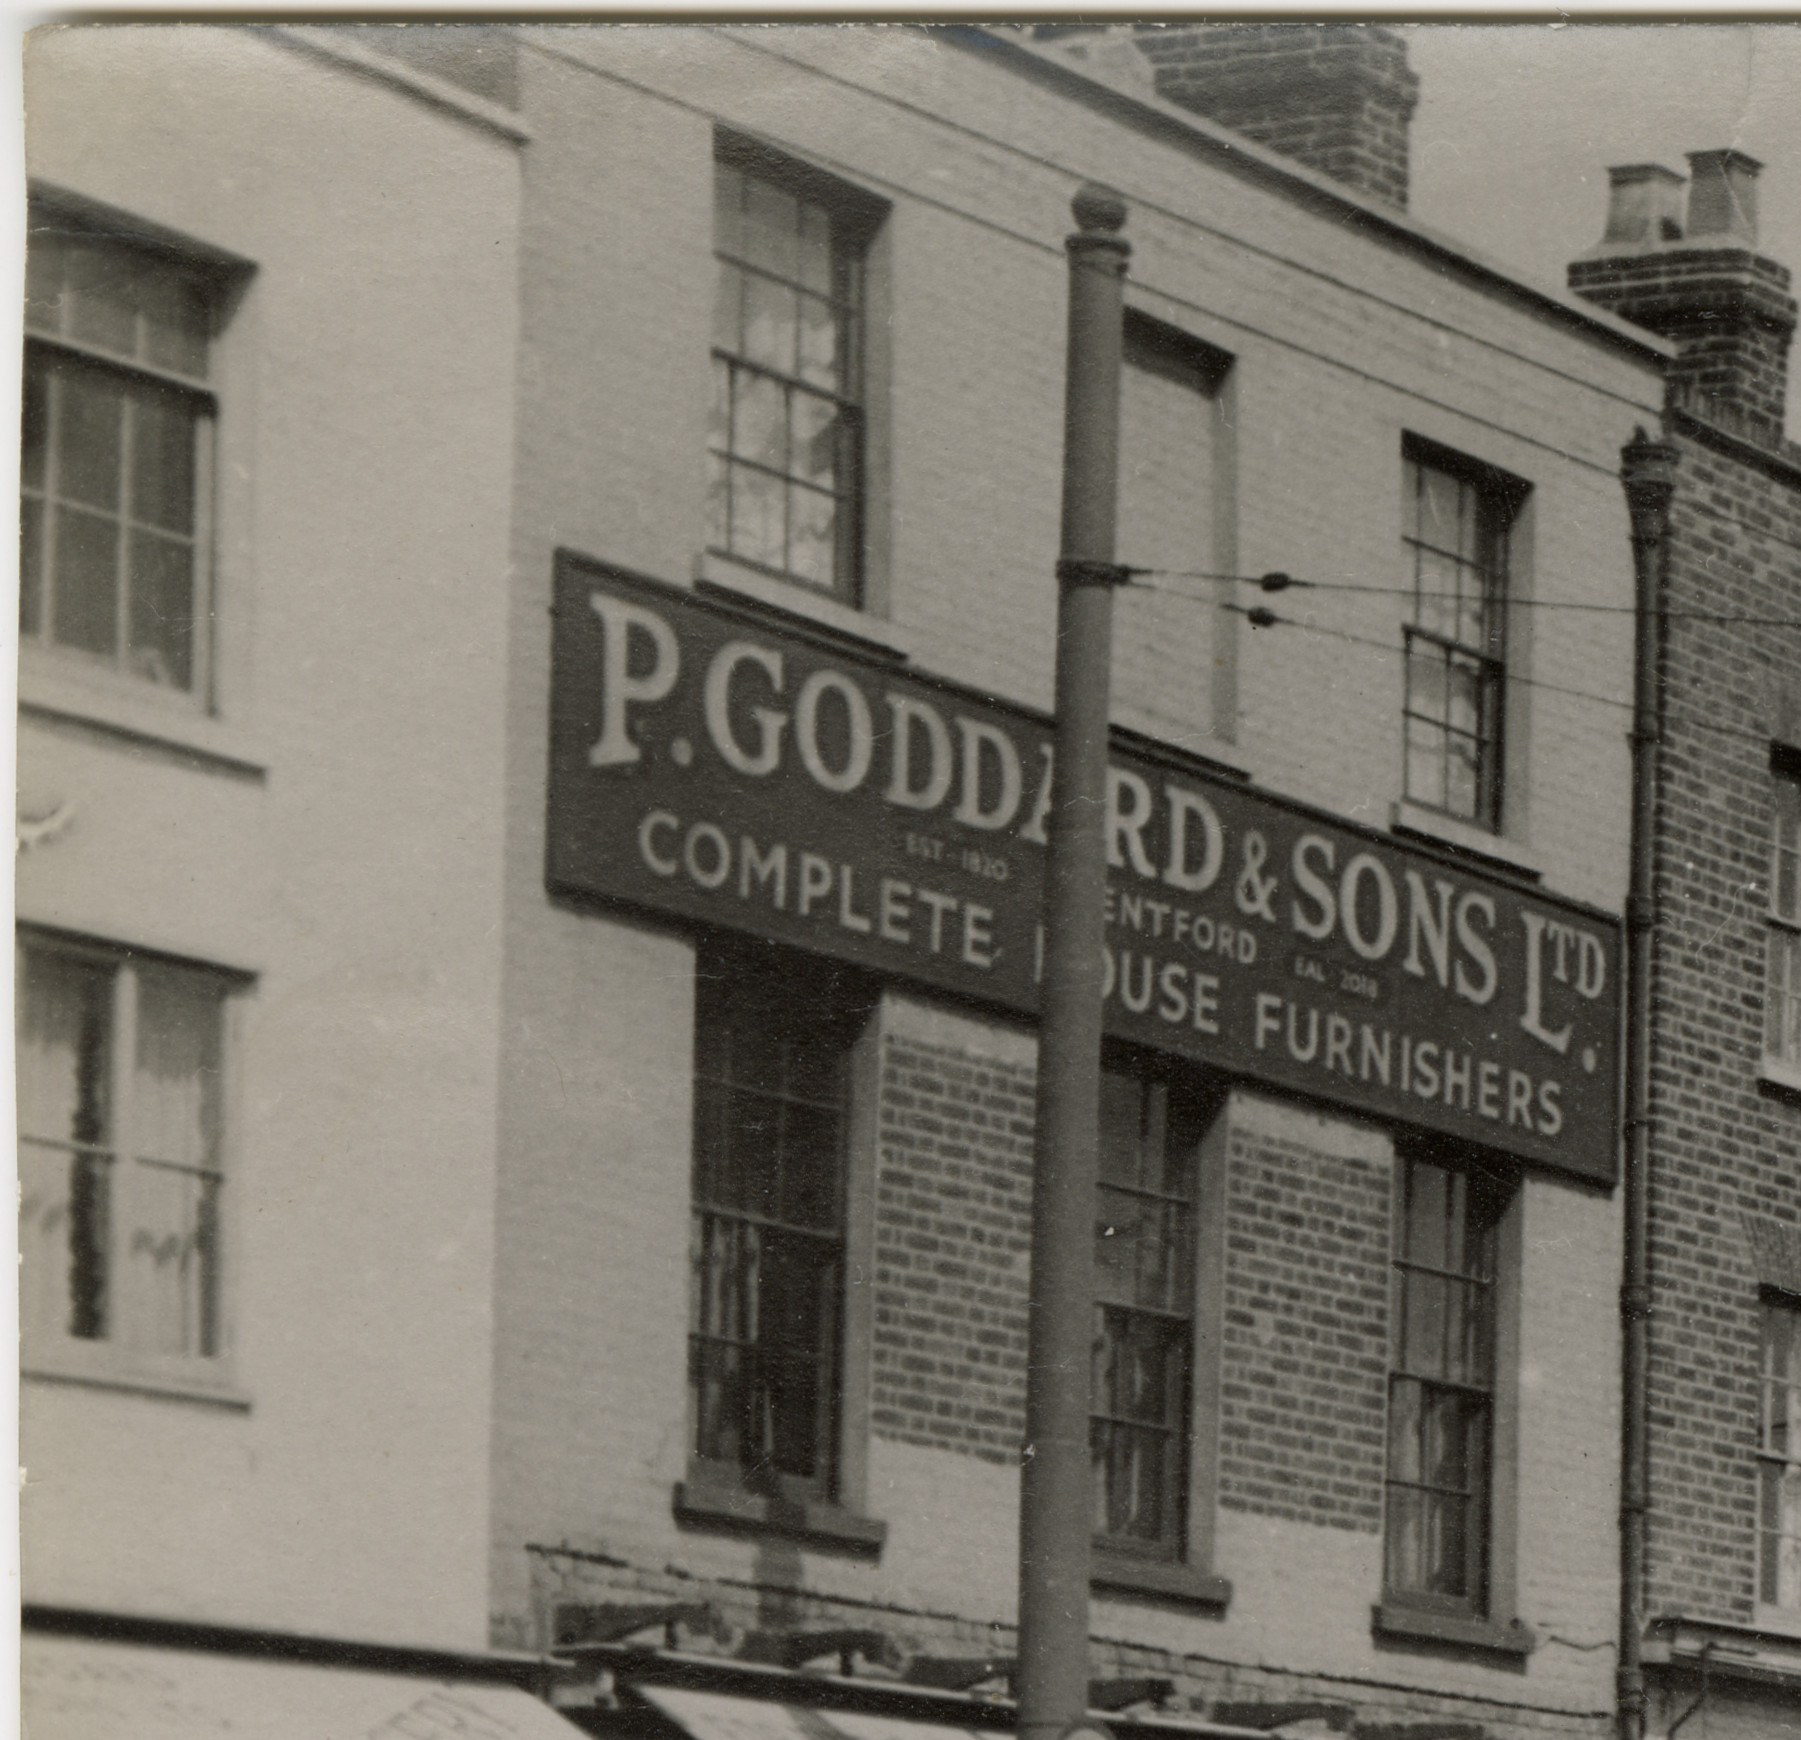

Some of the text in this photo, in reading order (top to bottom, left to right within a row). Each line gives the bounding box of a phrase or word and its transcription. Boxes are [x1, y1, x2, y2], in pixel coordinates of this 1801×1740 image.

[637, 810, 1564, 1138] COMPLETE USE FURNISHERS
[1102, 887, 1258, 964] ENTFORD
[1233, 829, 1280, 922] &
[1291, 834, 1497, 1005] SONS
